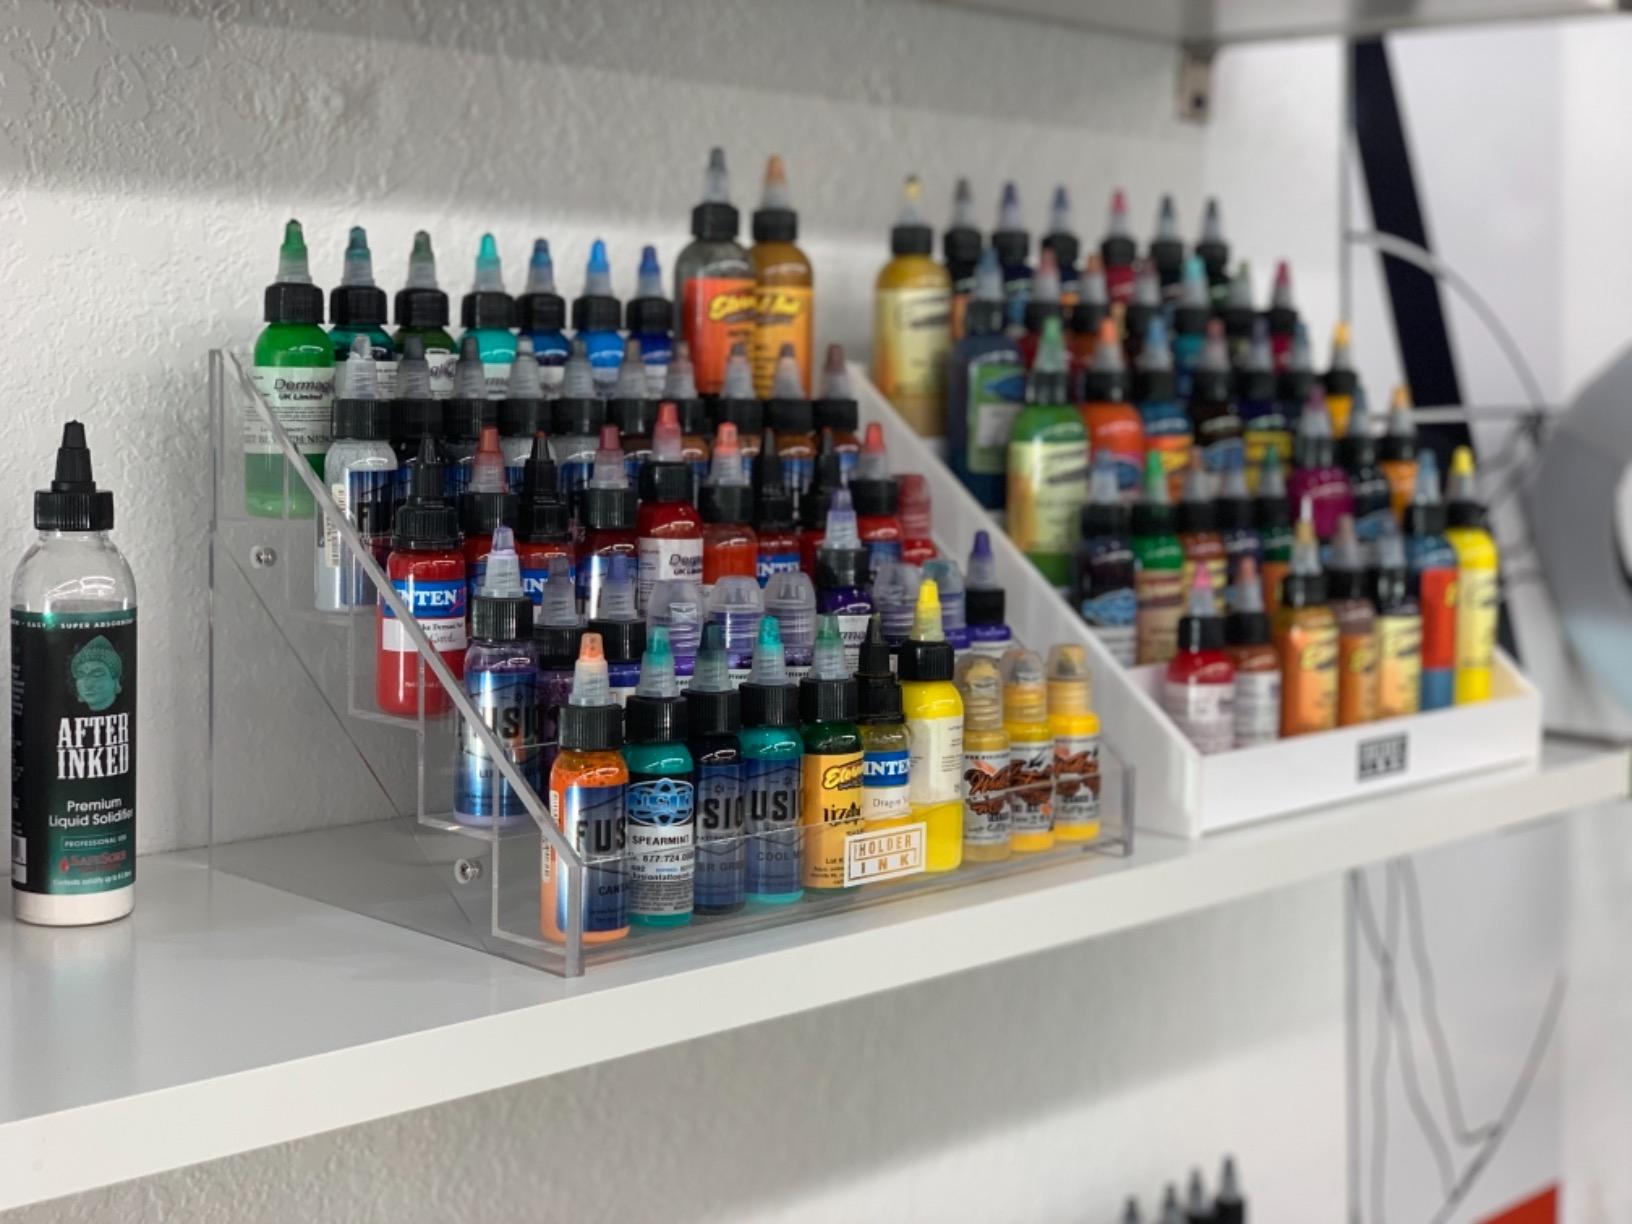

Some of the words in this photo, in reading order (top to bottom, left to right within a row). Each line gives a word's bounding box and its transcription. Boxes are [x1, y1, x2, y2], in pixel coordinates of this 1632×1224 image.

[56, 712, 129, 748] AFTER
[57, 744, 129, 779] INKED
[67, 798, 122, 813] Premium
[48, 815, 89, 829] Liquid
[631, 834, 690, 847] SPEARMINT
[858, 833, 912, 857] HOLDER
